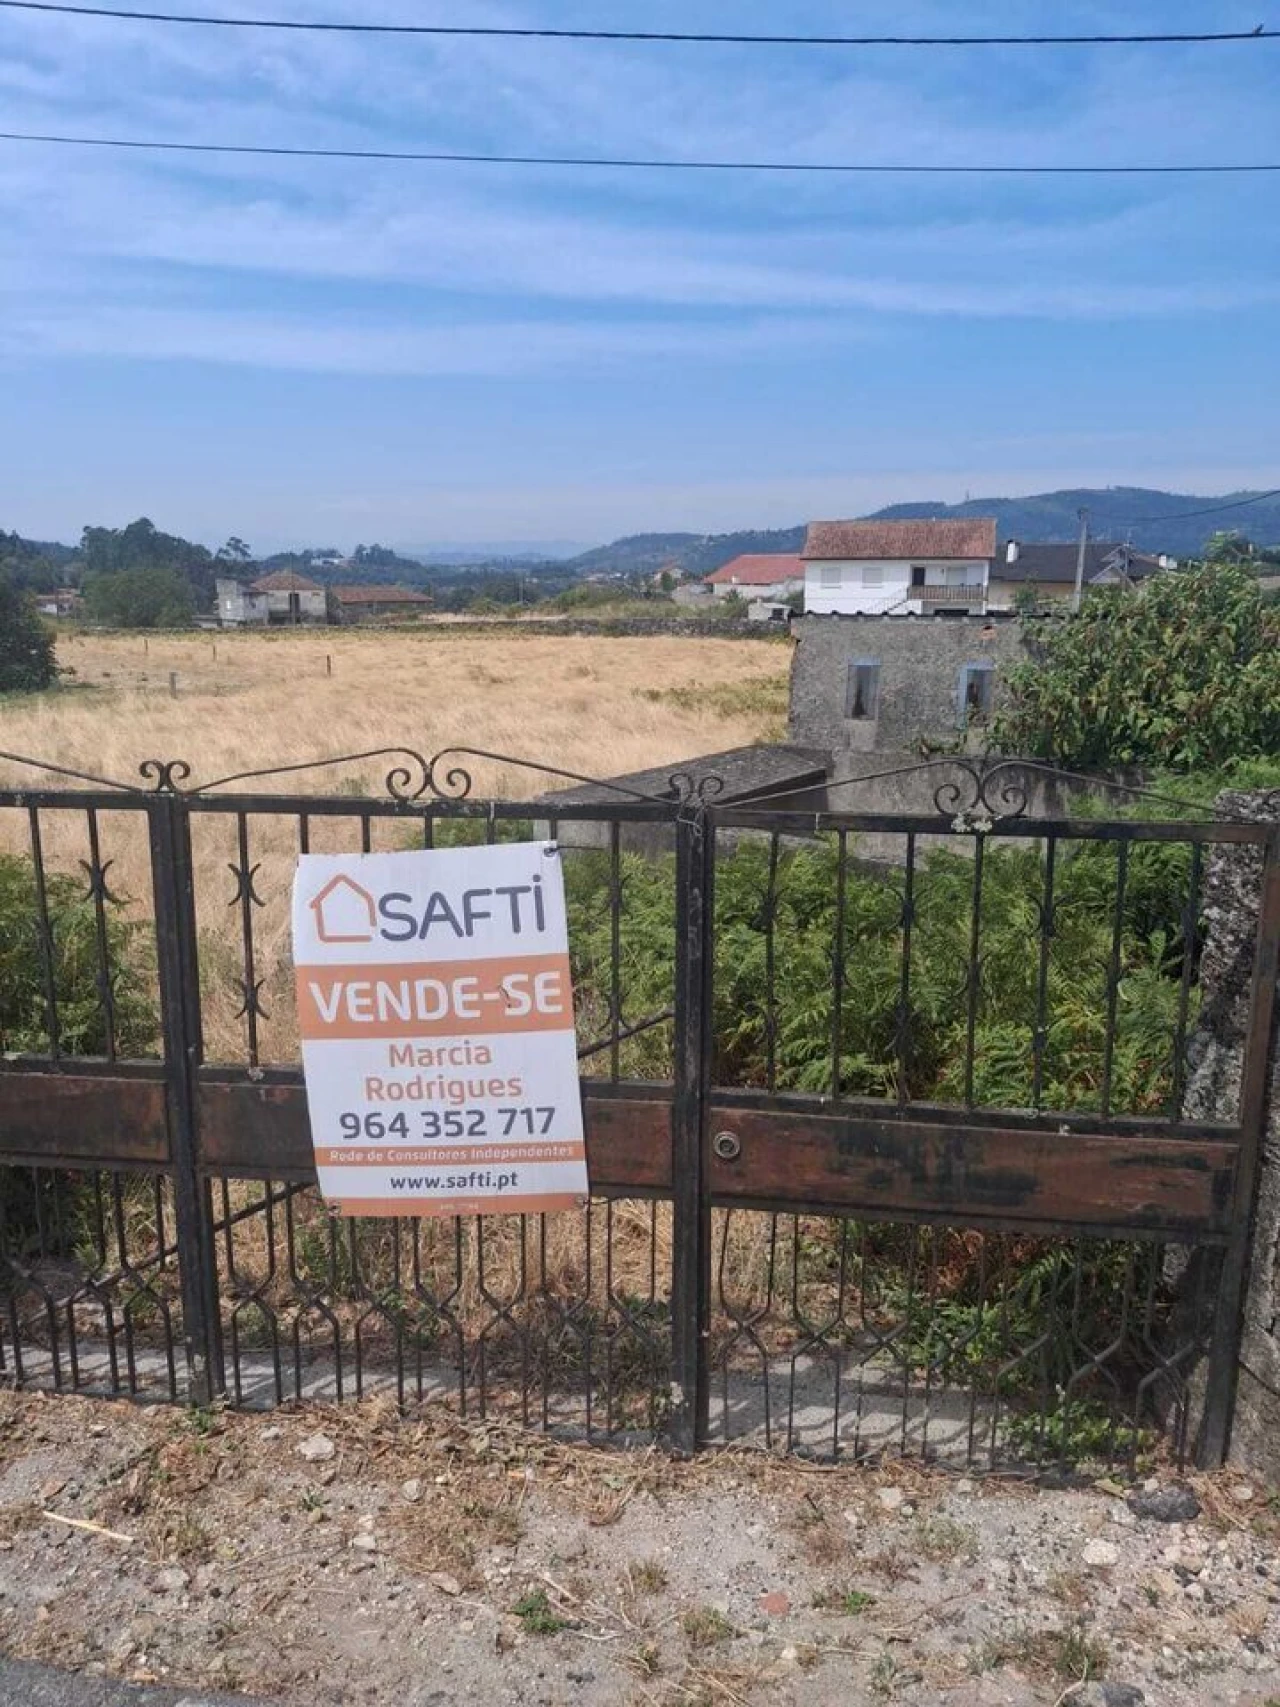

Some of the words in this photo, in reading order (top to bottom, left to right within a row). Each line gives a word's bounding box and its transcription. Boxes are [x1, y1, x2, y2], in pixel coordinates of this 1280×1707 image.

[308, 970, 563, 1024] VENDE-SE
[388, 1040, 493, 1068] Marcia
[365, 1074, 523, 1105] Rodrigues
[339, 1111, 410, 1139] 964
[420, 1109, 488, 1139] 352
[497, 1107, 556, 1136] 717
[329, 1149, 363, 1162] Rede
[367, 1149, 383, 1162] de
[386, 1148, 467, 1161] Consultores
[470, 1145, 574, 1161] Independentes
[390, 1171, 518, 1191] www.safti.pt
